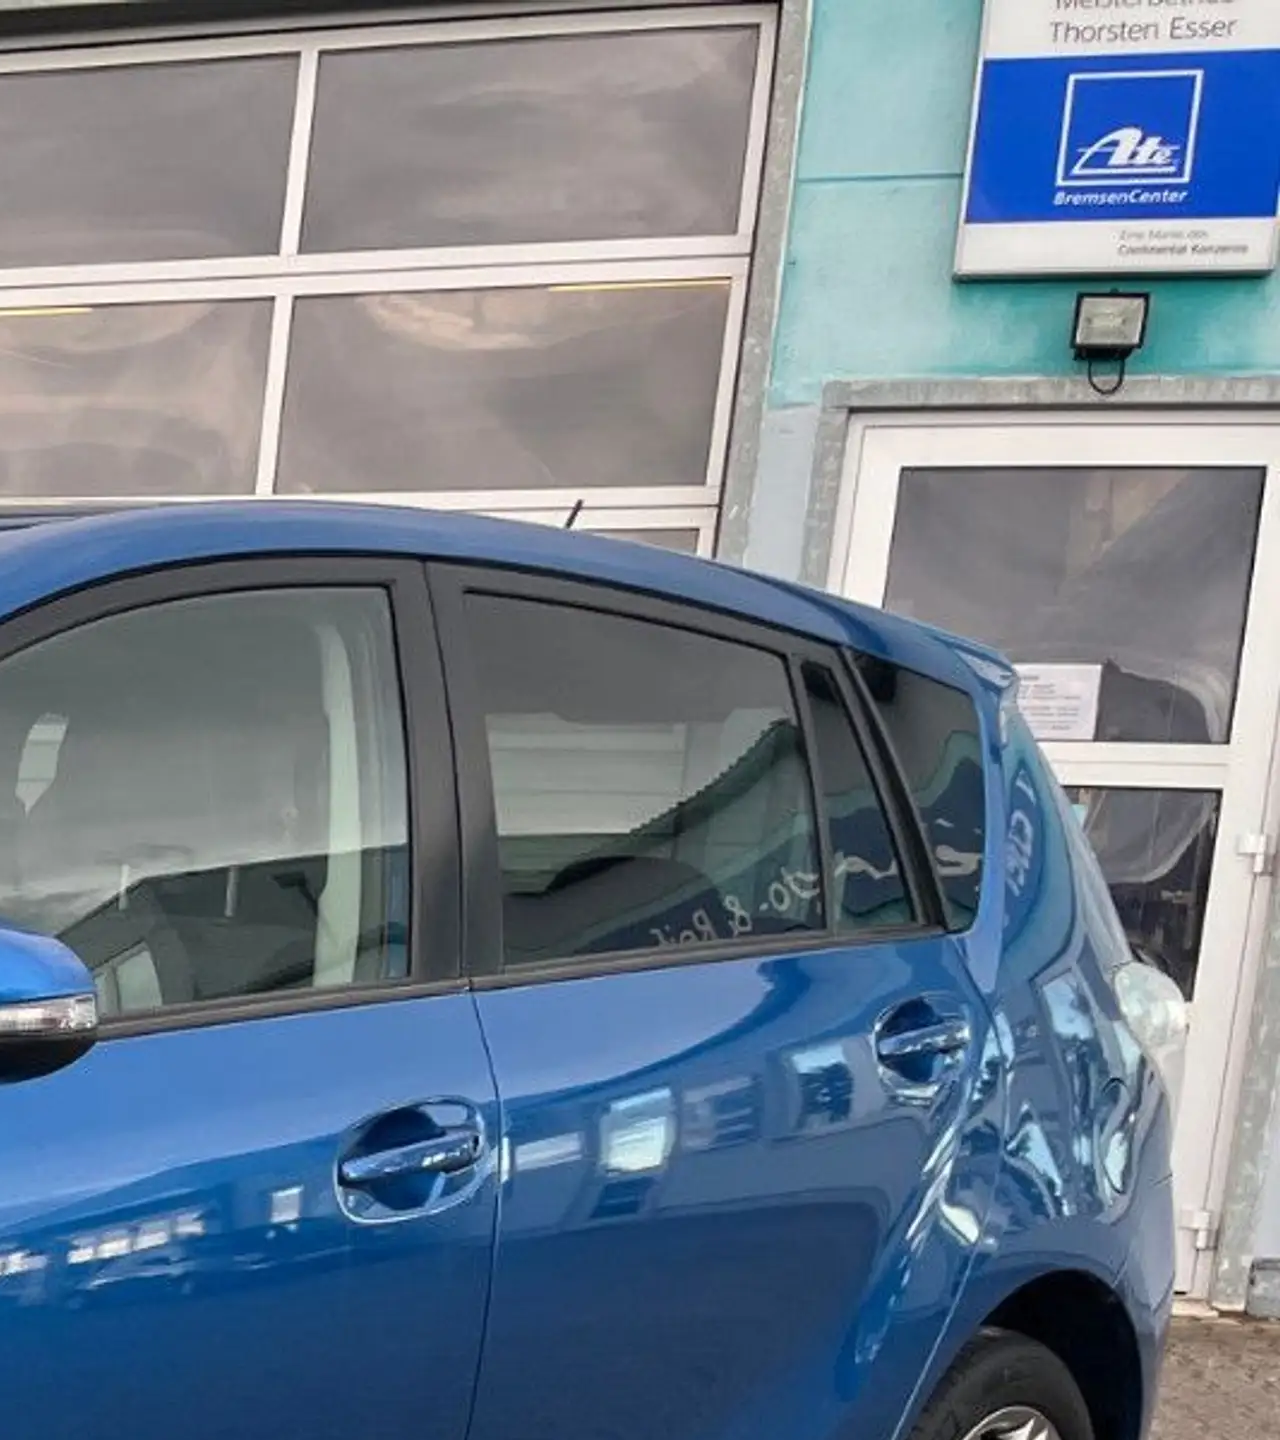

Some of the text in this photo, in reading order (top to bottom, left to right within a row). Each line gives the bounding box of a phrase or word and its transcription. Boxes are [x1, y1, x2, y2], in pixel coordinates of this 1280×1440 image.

[1050, 17, 1239, 44] Thorsten Esser
[1052, 188, 1189, 207] BremsenCenter
